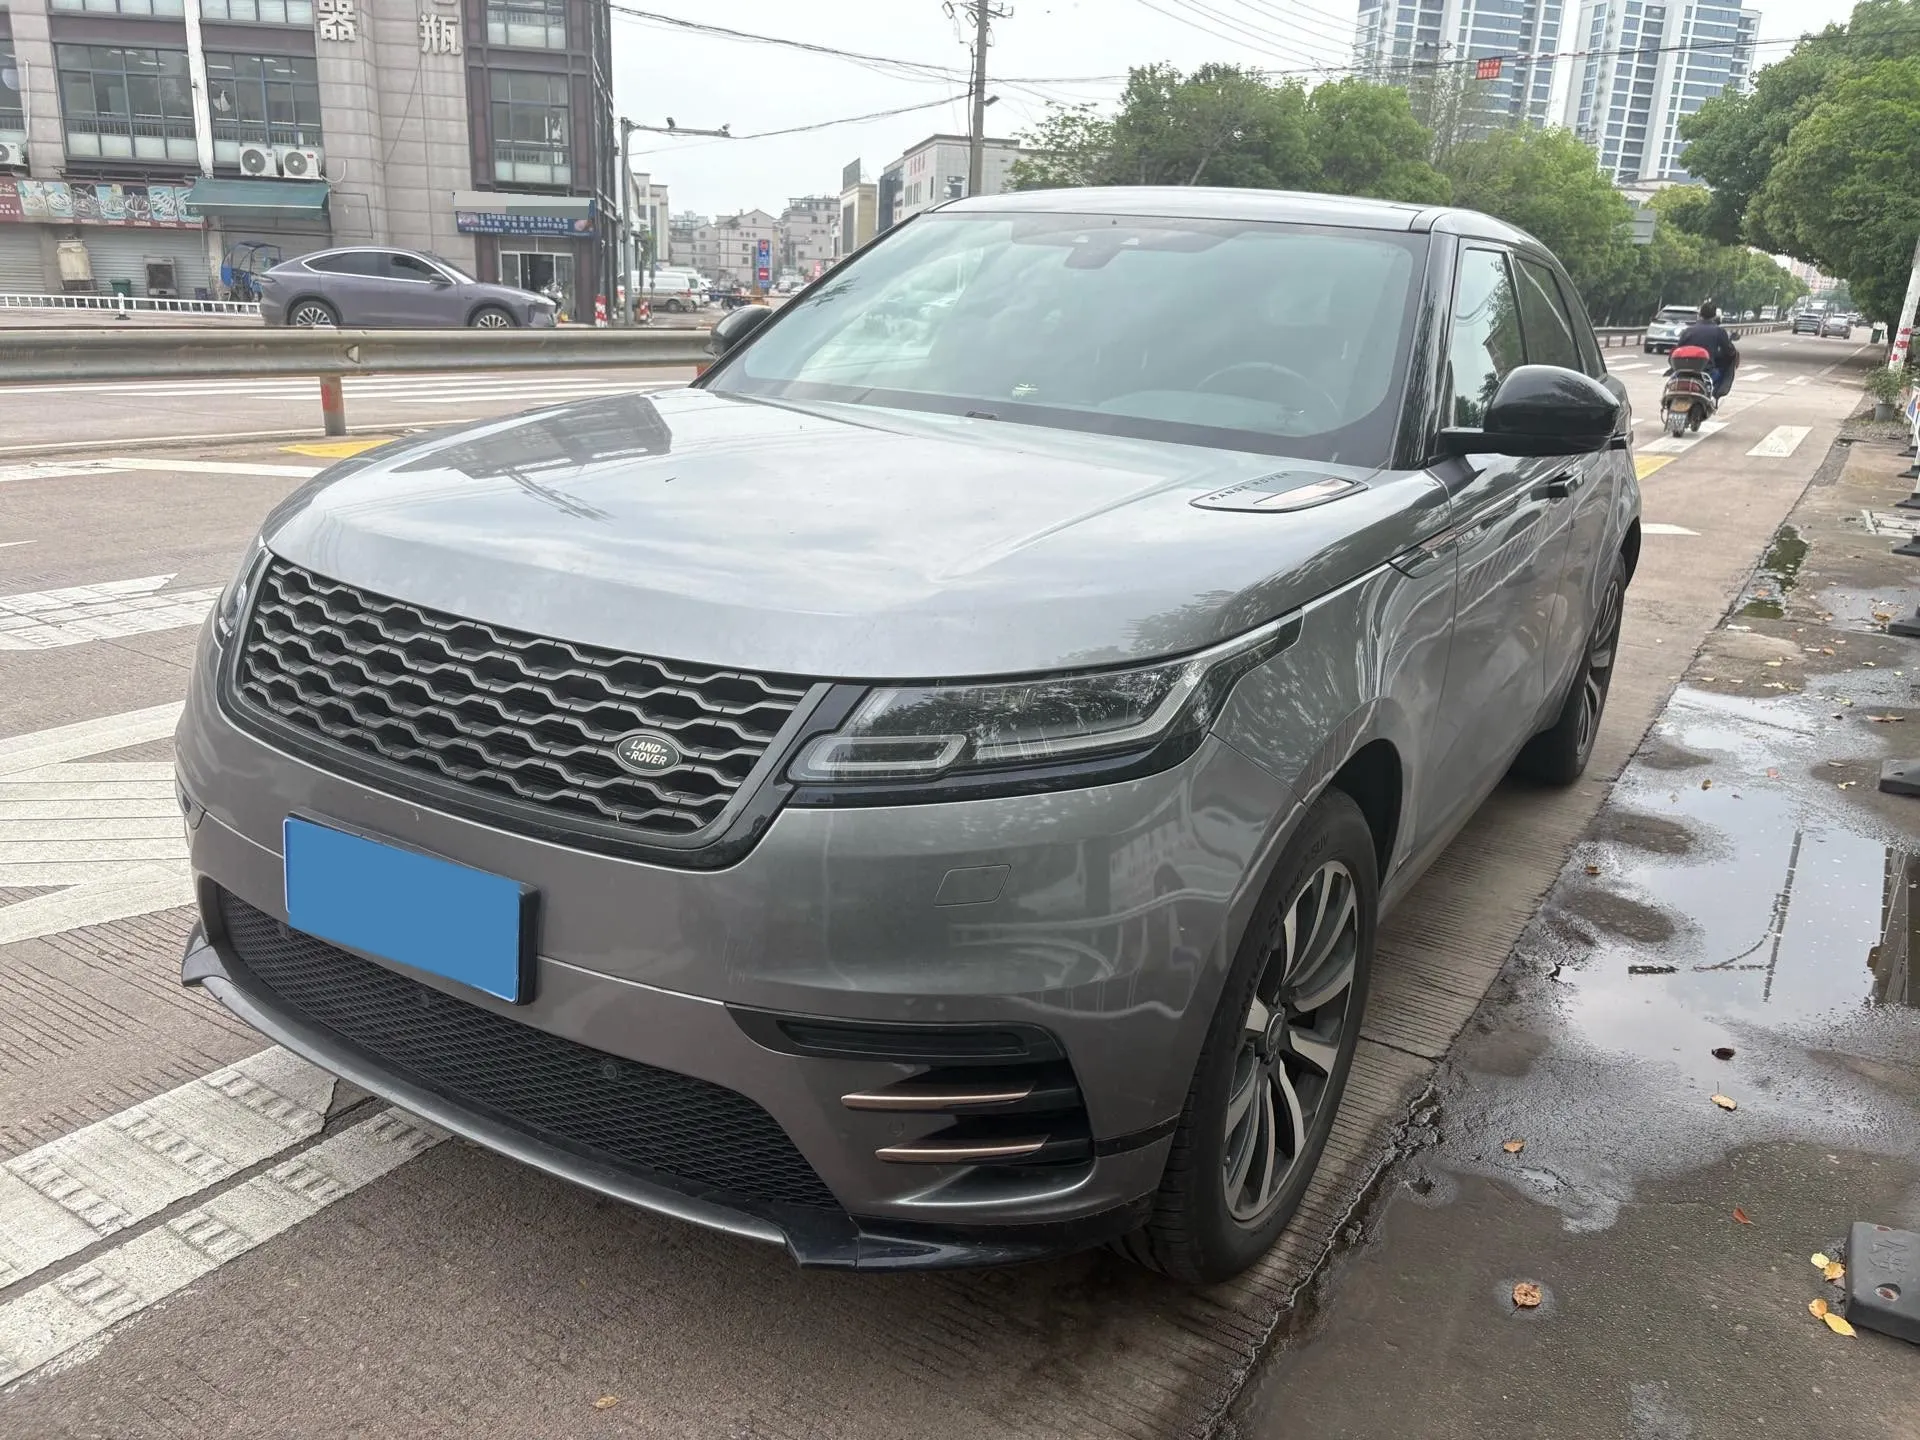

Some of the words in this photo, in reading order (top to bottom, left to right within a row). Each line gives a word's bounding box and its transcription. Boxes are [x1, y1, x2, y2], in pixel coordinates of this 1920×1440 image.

[317, 0, 357, 41] 器
[419, 0, 463, 56] 瓶
[1209, 485, 1250, 500] RANGE
[1252, 472, 1292, 485] ROVER
[630, 752, 667, 765] ROVER
[631, 740, 661, 753] LAND
